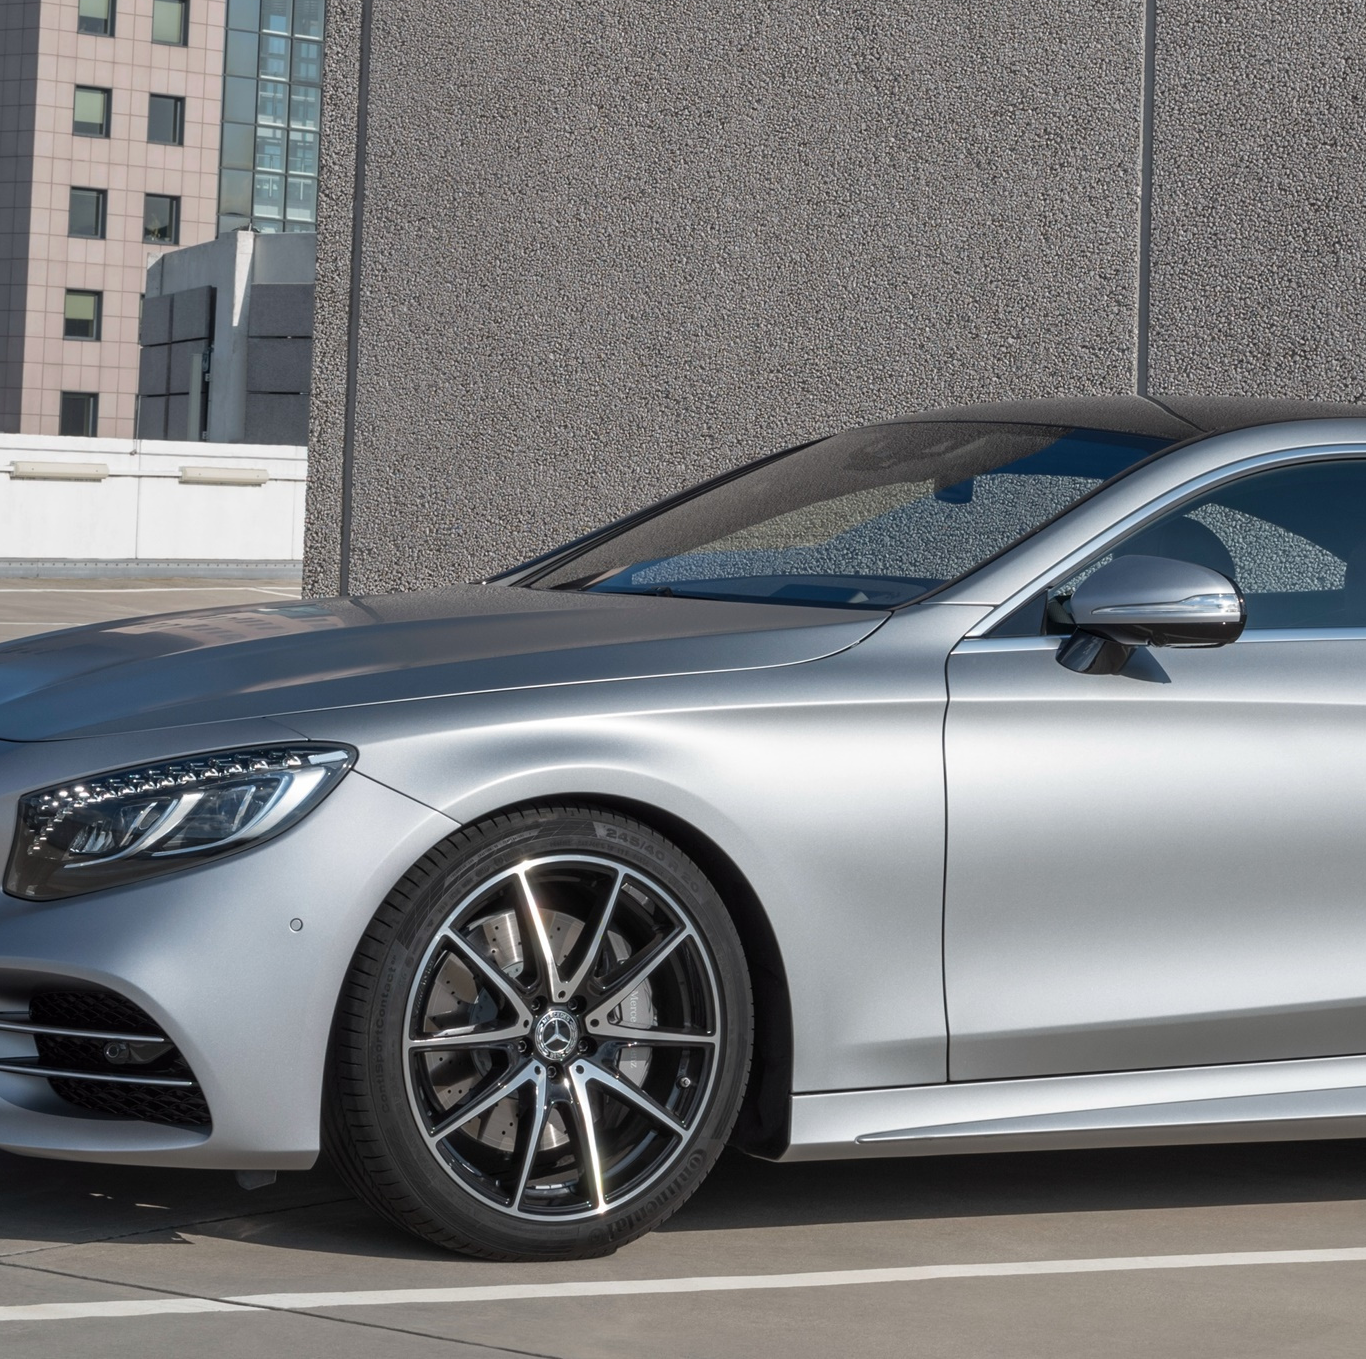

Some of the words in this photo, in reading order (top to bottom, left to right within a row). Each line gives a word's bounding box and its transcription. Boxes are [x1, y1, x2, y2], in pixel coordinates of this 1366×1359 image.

[606, 827, 666, 862] 245/40
[681, 872, 700, 893] 20
[606, 1148, 708, 1241] Continental
